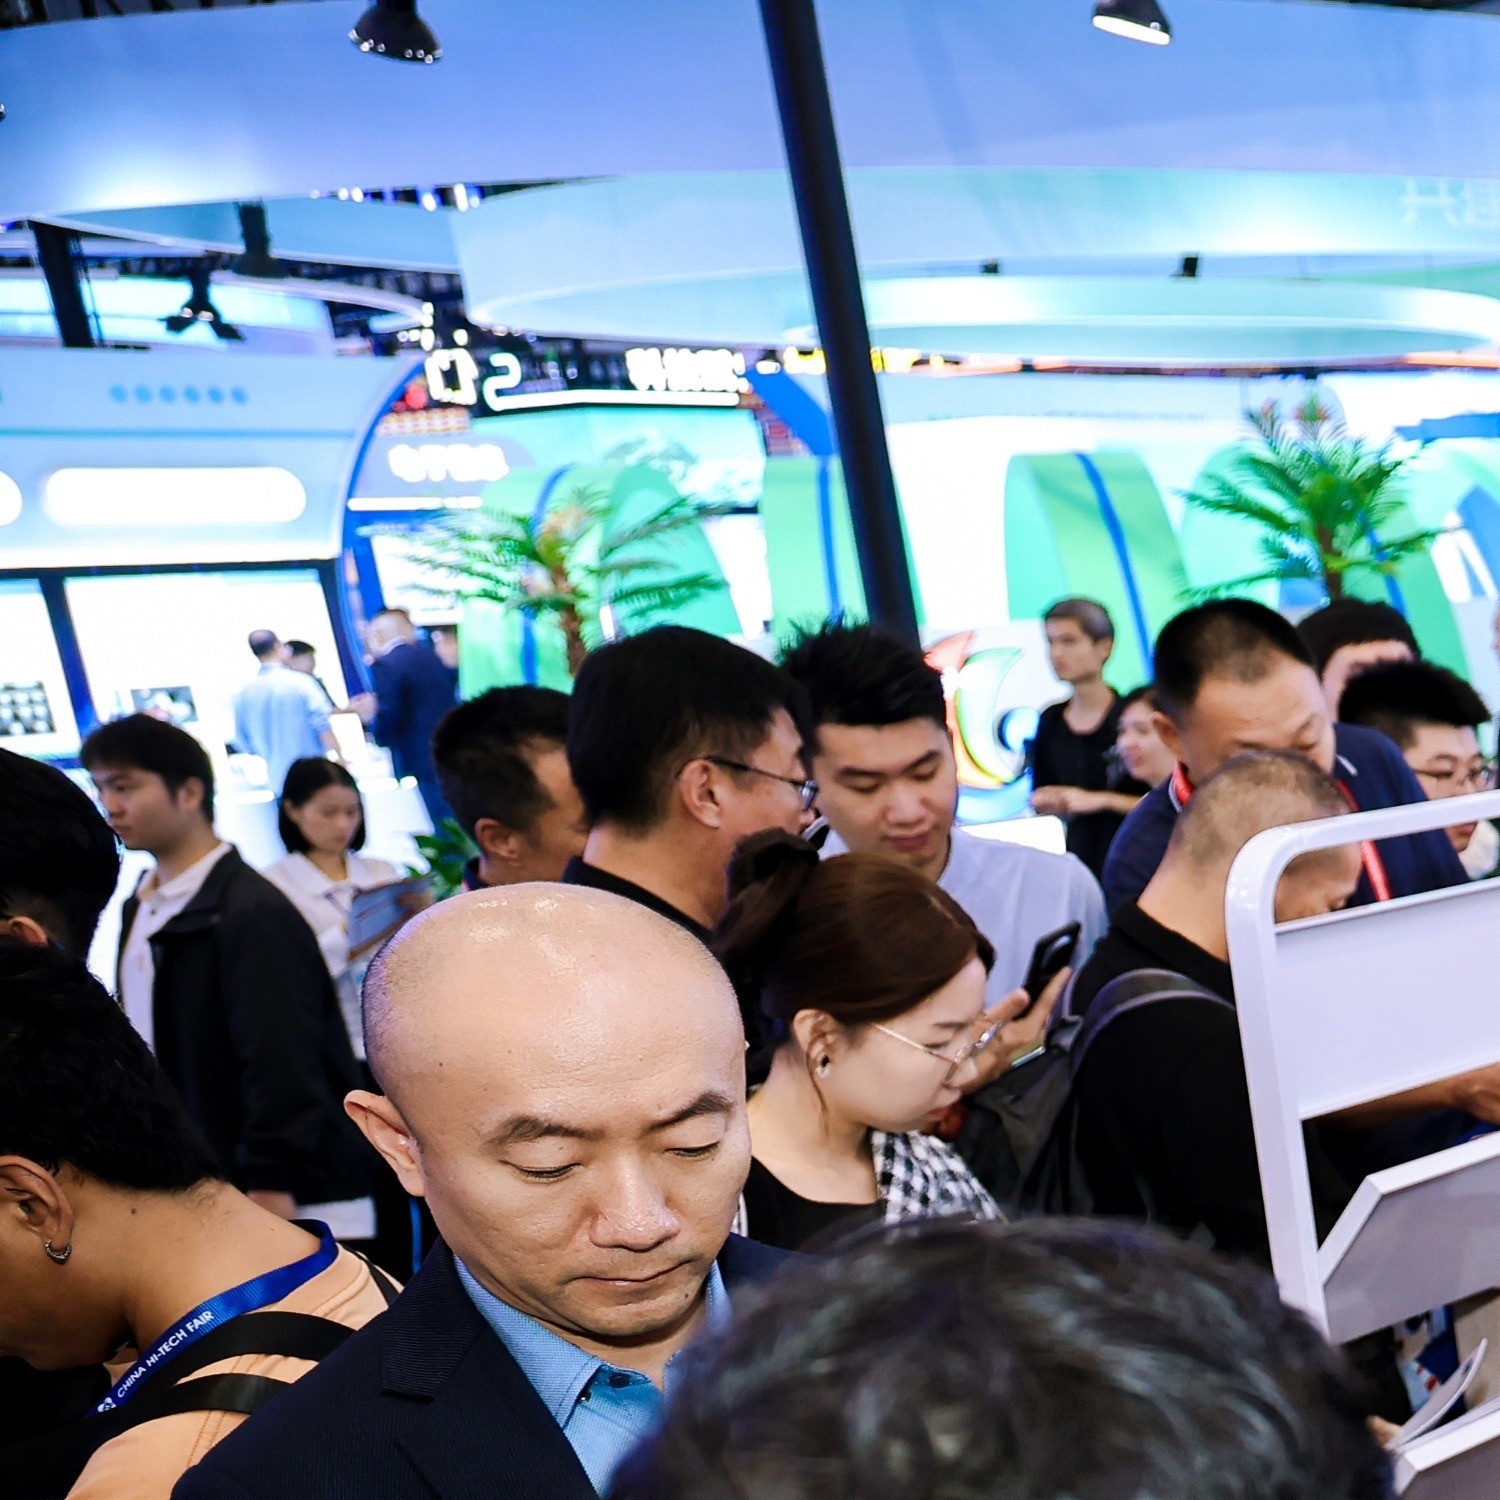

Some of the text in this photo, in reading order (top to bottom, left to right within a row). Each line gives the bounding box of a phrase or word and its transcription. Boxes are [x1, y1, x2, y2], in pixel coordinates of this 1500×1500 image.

[117, 1310, 215, 1398] CHINA HI-TECH FAIR
